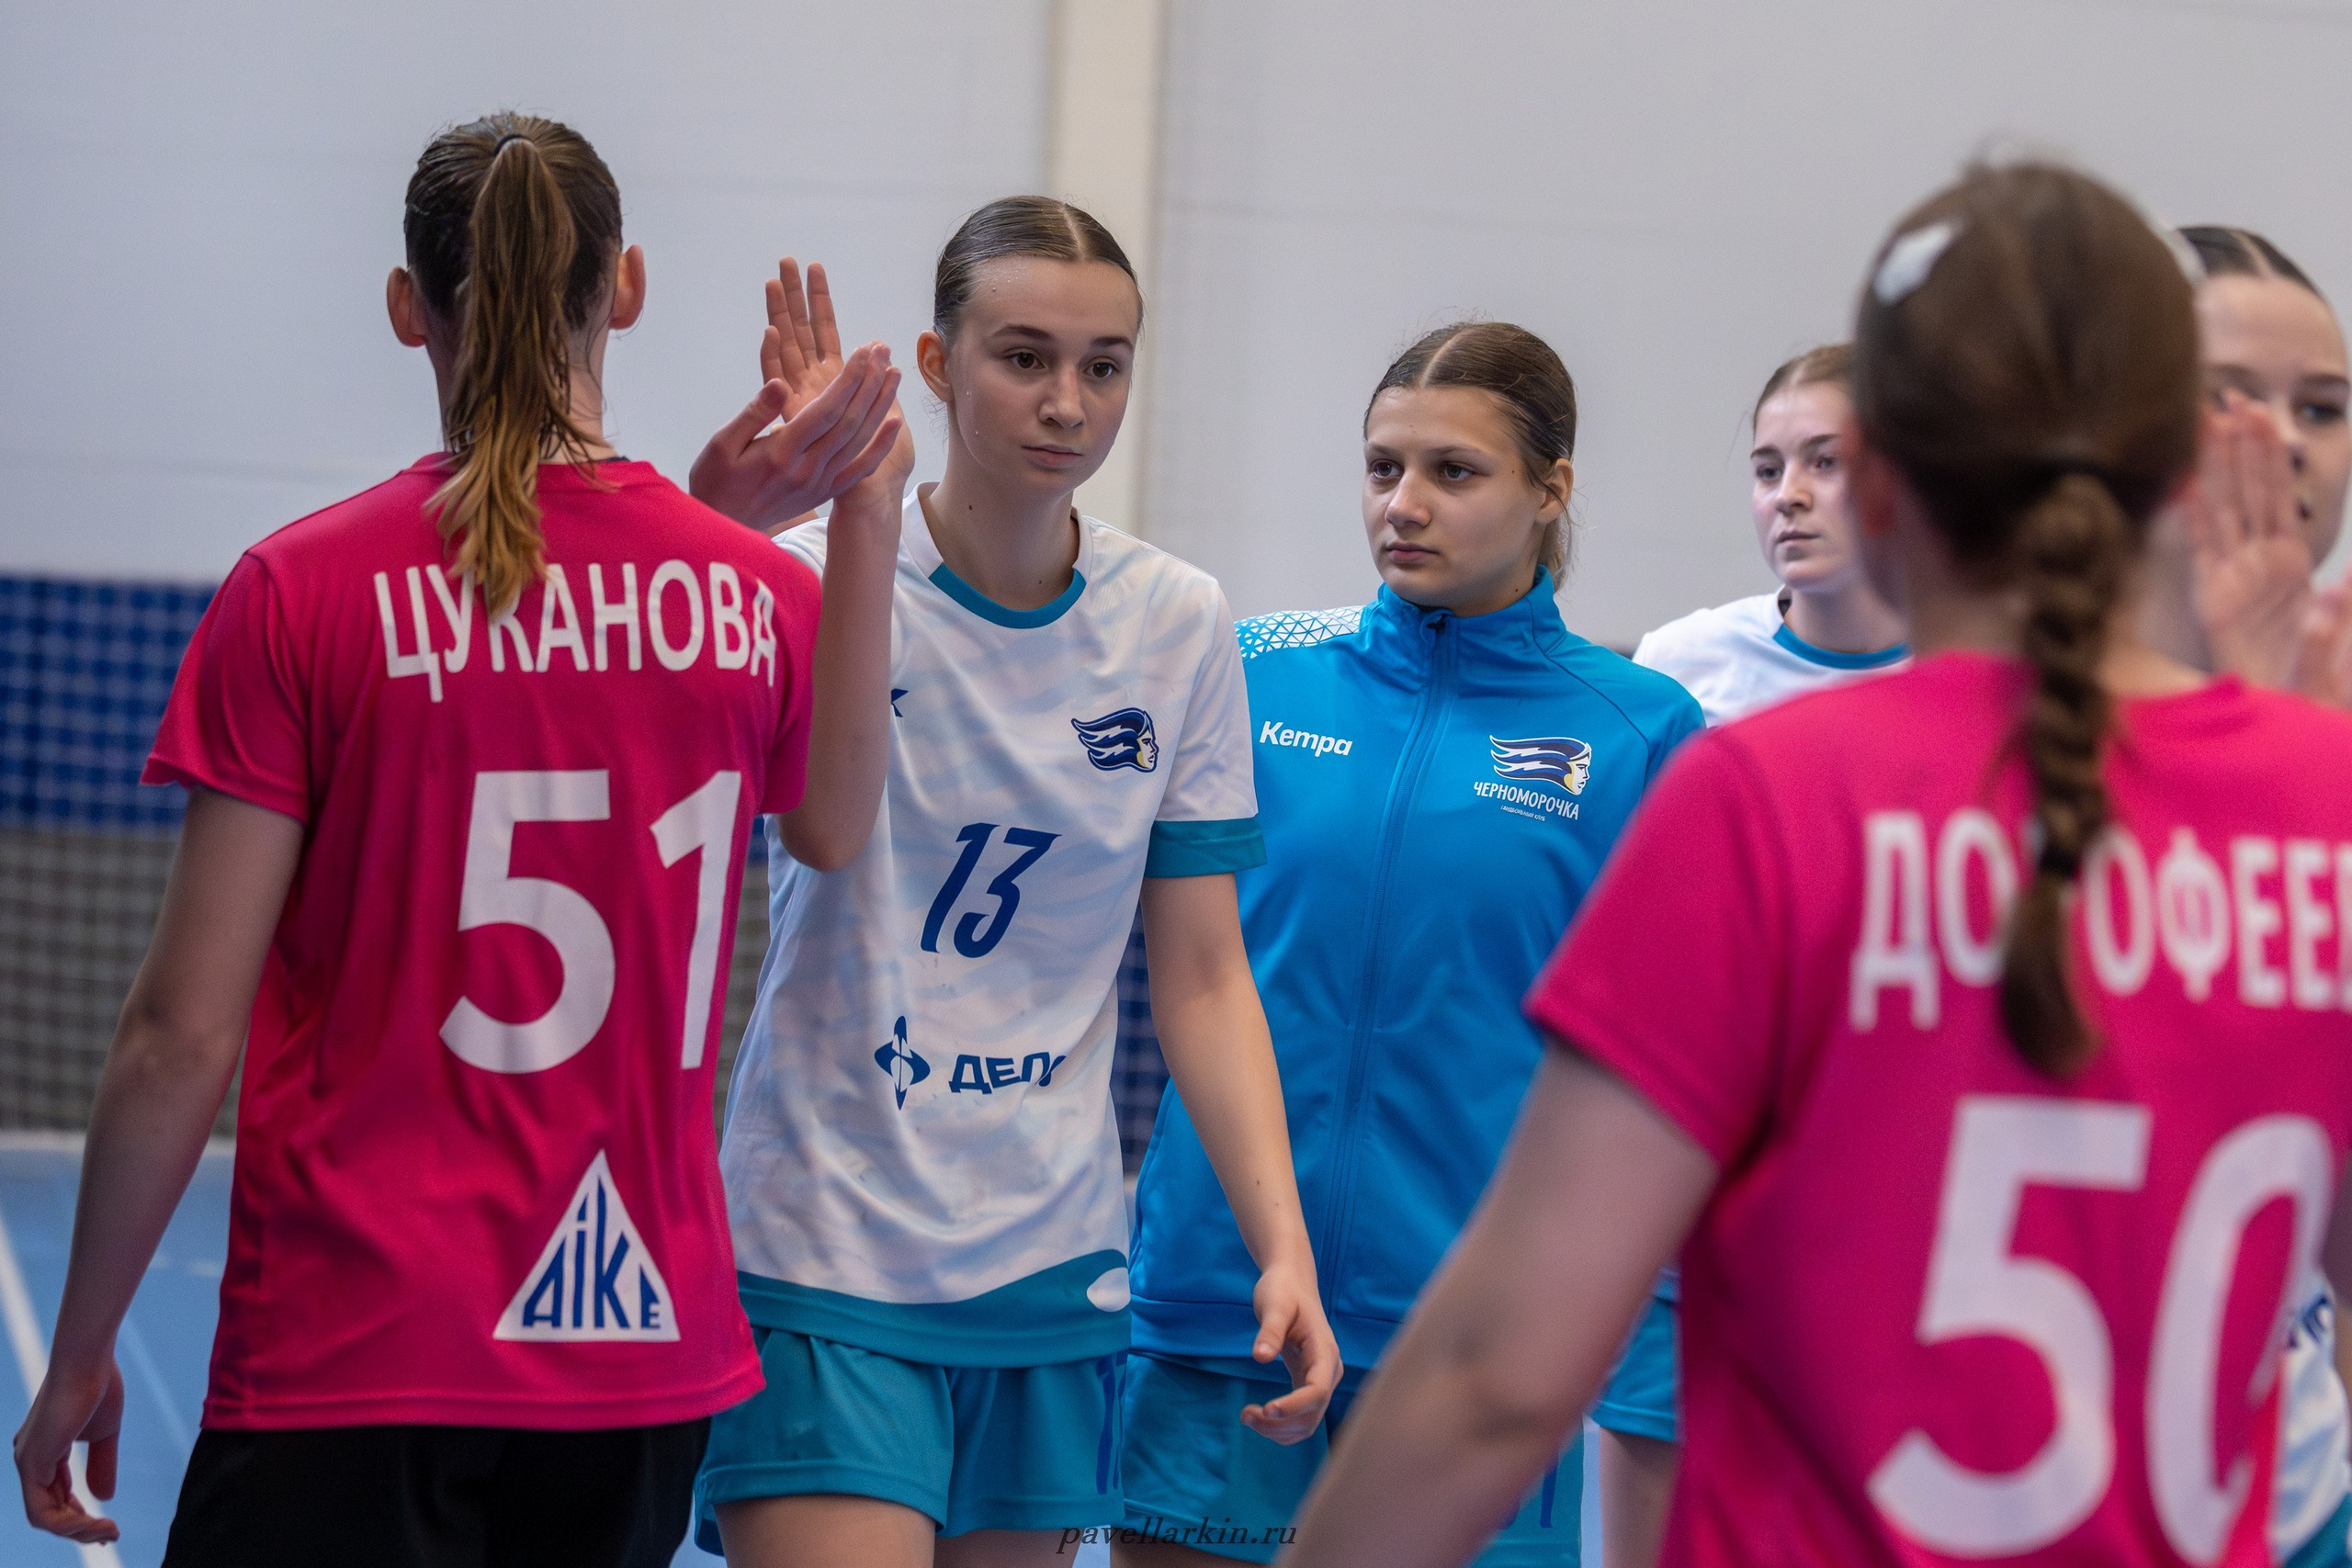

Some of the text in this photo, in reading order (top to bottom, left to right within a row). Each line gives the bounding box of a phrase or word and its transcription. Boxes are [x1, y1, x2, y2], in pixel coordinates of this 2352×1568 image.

[1259, 720, 1353, 758] Kempa
[1473, 781, 1580, 820] ЧЕРНОМОРОЧКА
[438, 769, 741, 1075] 51
[921, 822, 1062, 958] 13
[1849, 808, 2352, 1032] ДООФЕЕ
[1866, 1093, 2335, 1568] 50
